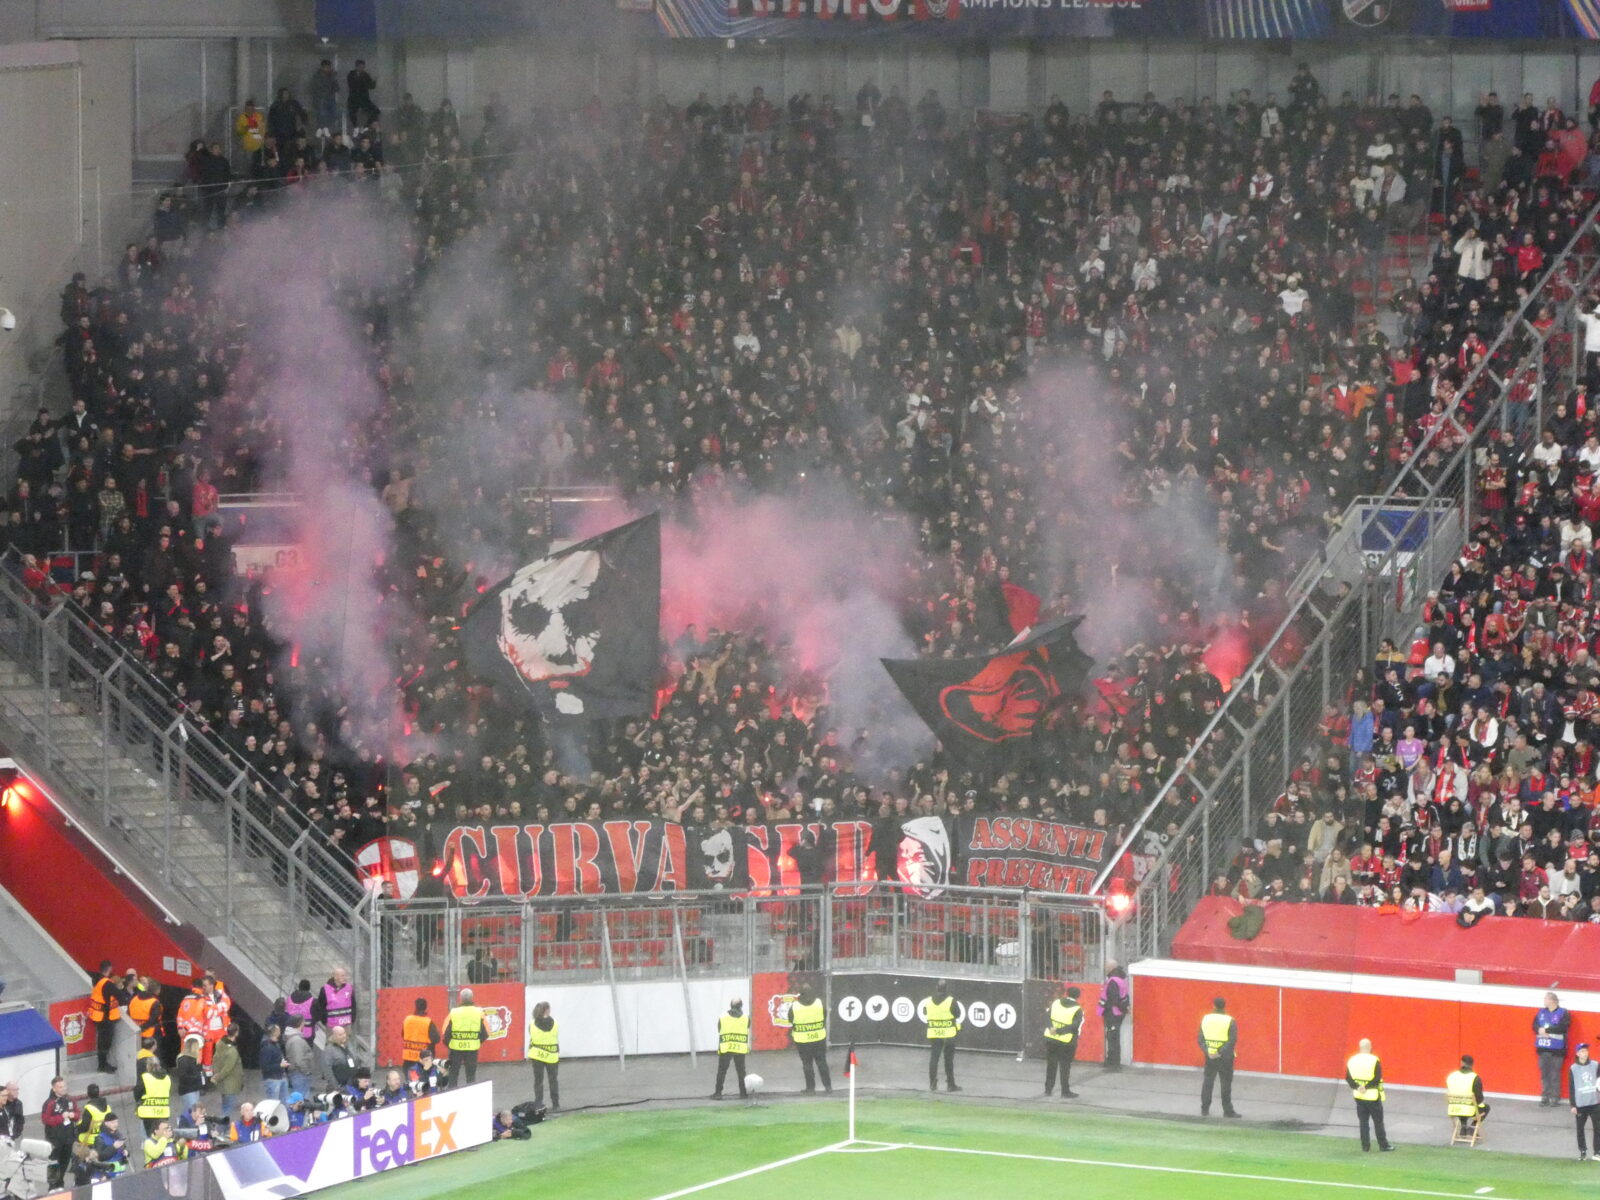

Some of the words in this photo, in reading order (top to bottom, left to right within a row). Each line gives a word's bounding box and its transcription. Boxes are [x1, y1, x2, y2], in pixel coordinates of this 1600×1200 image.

[969, 817, 1107, 862] ASSENTI
[442, 820, 699, 904] CURVA
[967, 857, 1097, 894] PRESENTI
[1538, 1038, 1552, 1046] 025
[143, 1098, 169, 1106] STEWAR
[353, 1096, 458, 1178] FedEx
